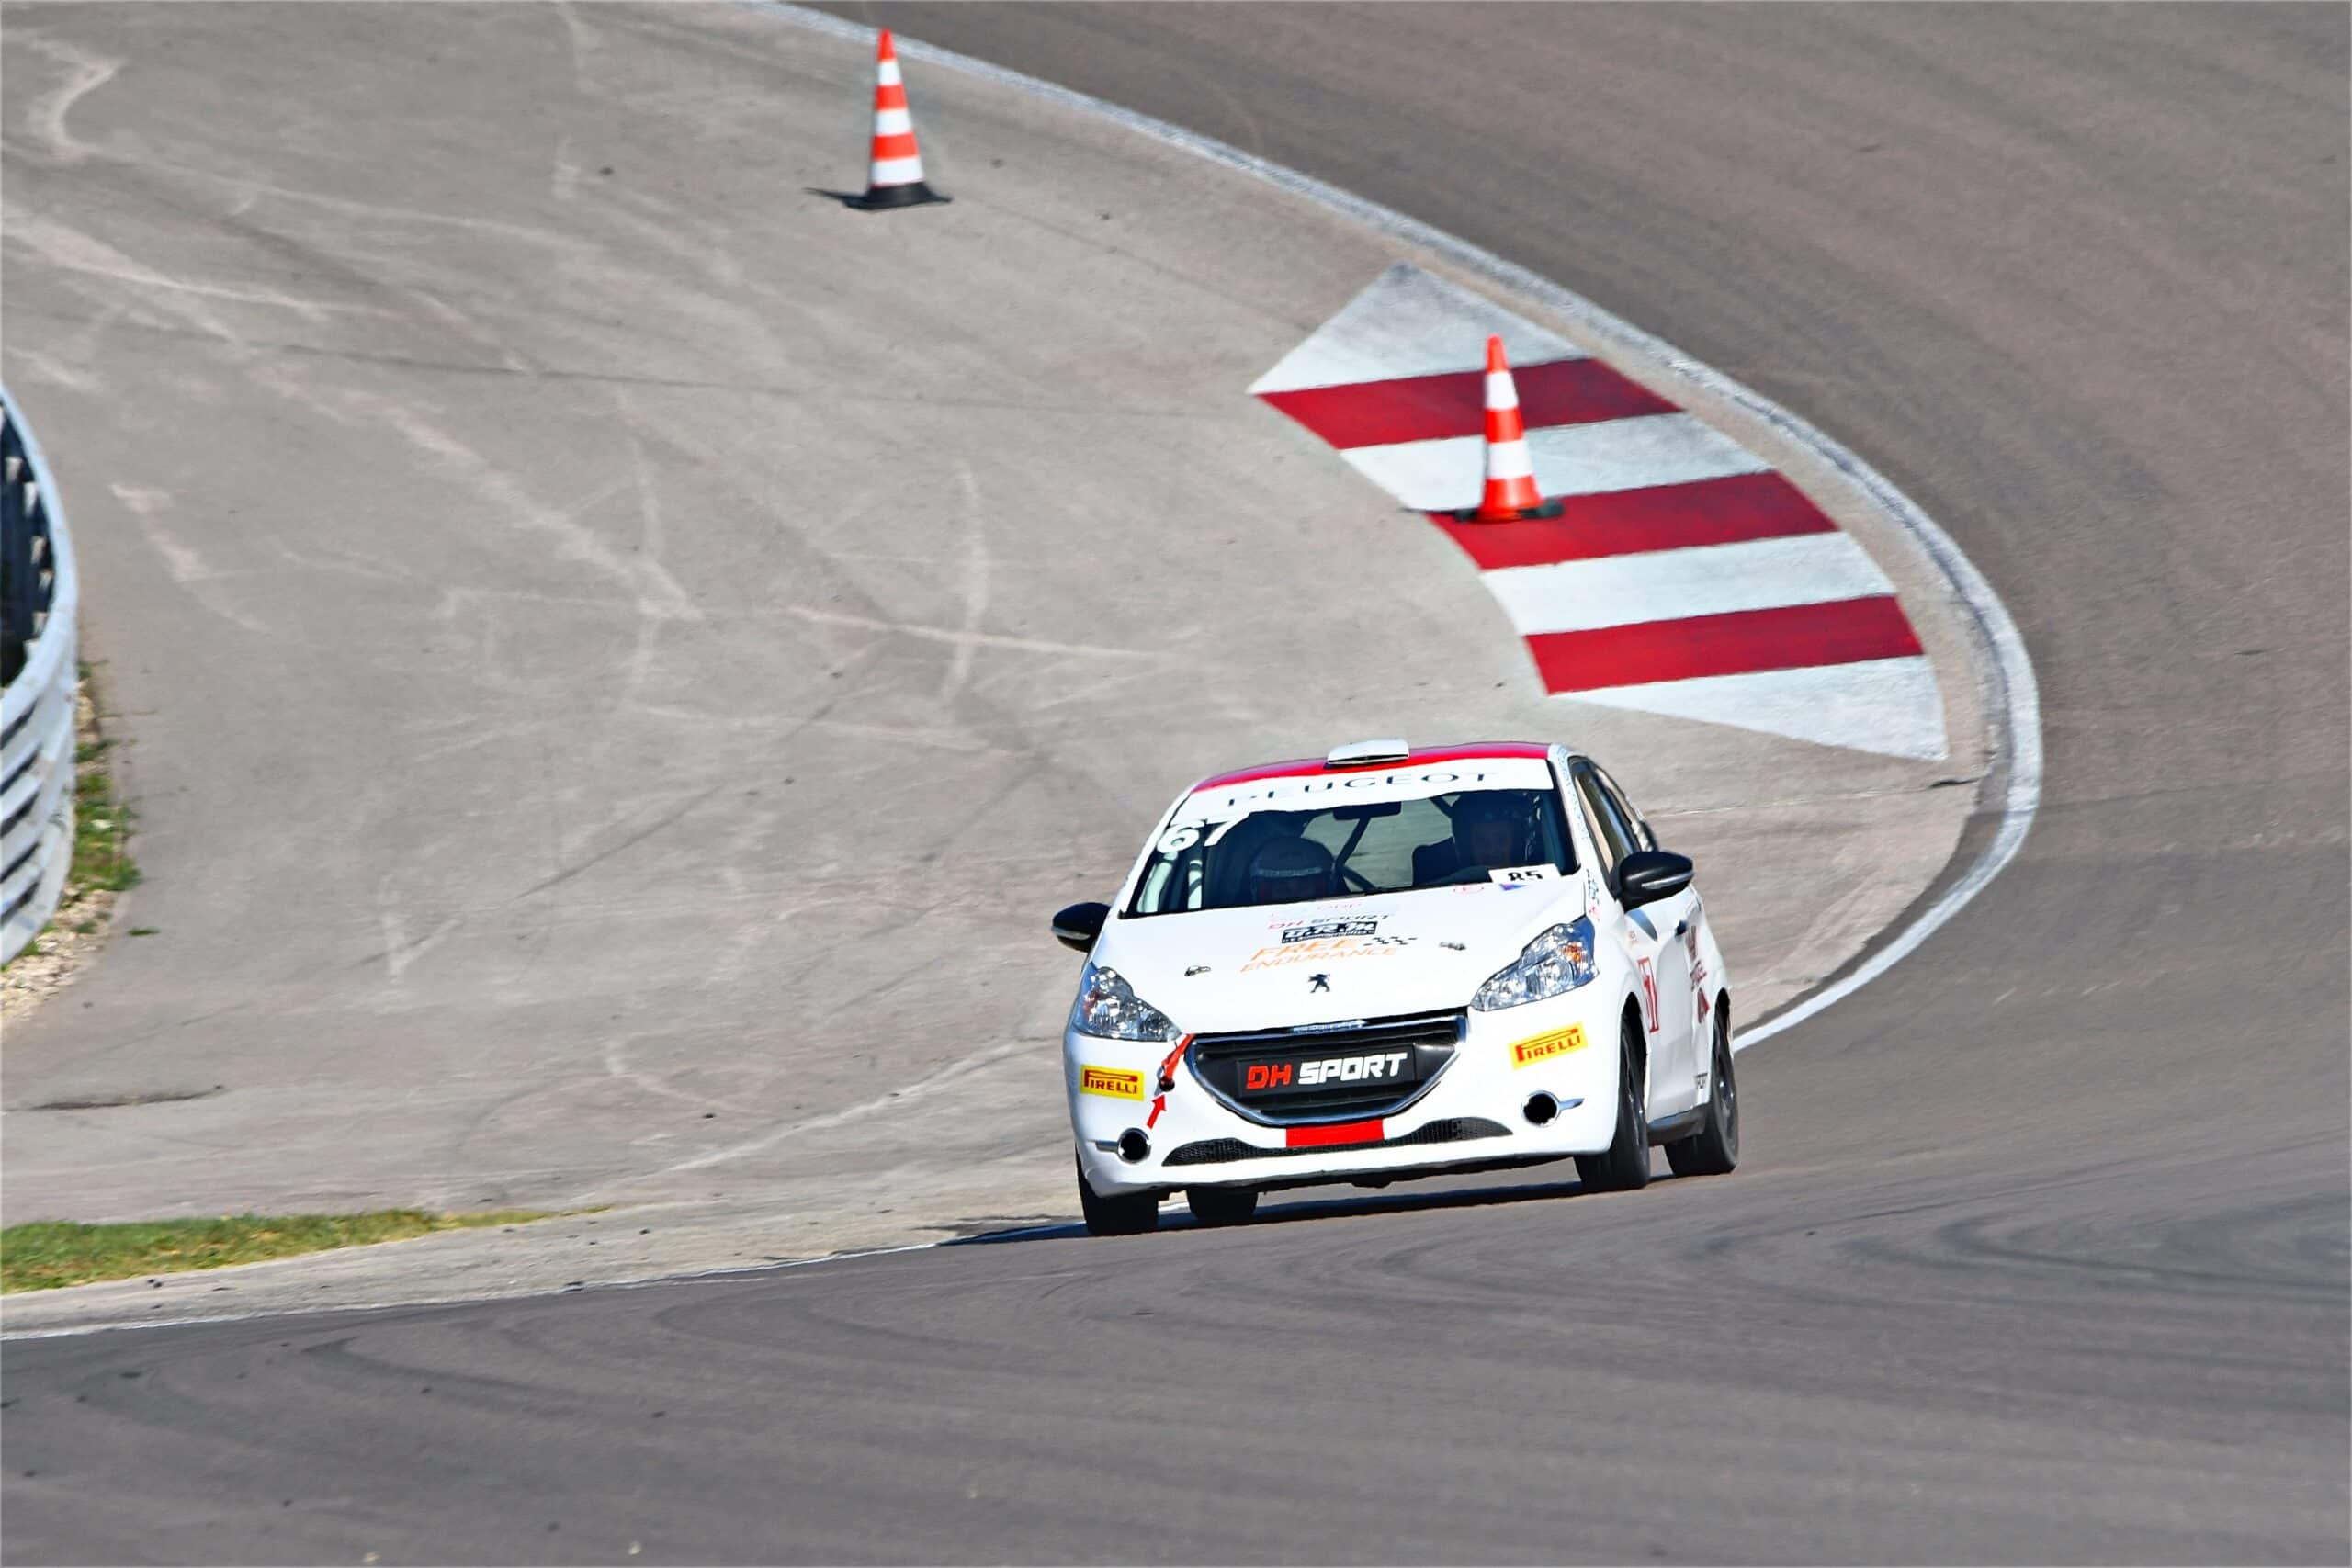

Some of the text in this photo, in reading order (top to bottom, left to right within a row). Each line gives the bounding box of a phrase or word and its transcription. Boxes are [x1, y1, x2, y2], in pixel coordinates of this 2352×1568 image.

[1227, 772, 1499, 807] PEUGEOT
[1156, 812, 1253, 853] 67
[1513, 1027, 1581, 1063] PIRELLI
[1083, 1069, 1138, 1095] PIRELLI
[1246, 1052, 1408, 1090] DH SPORT
